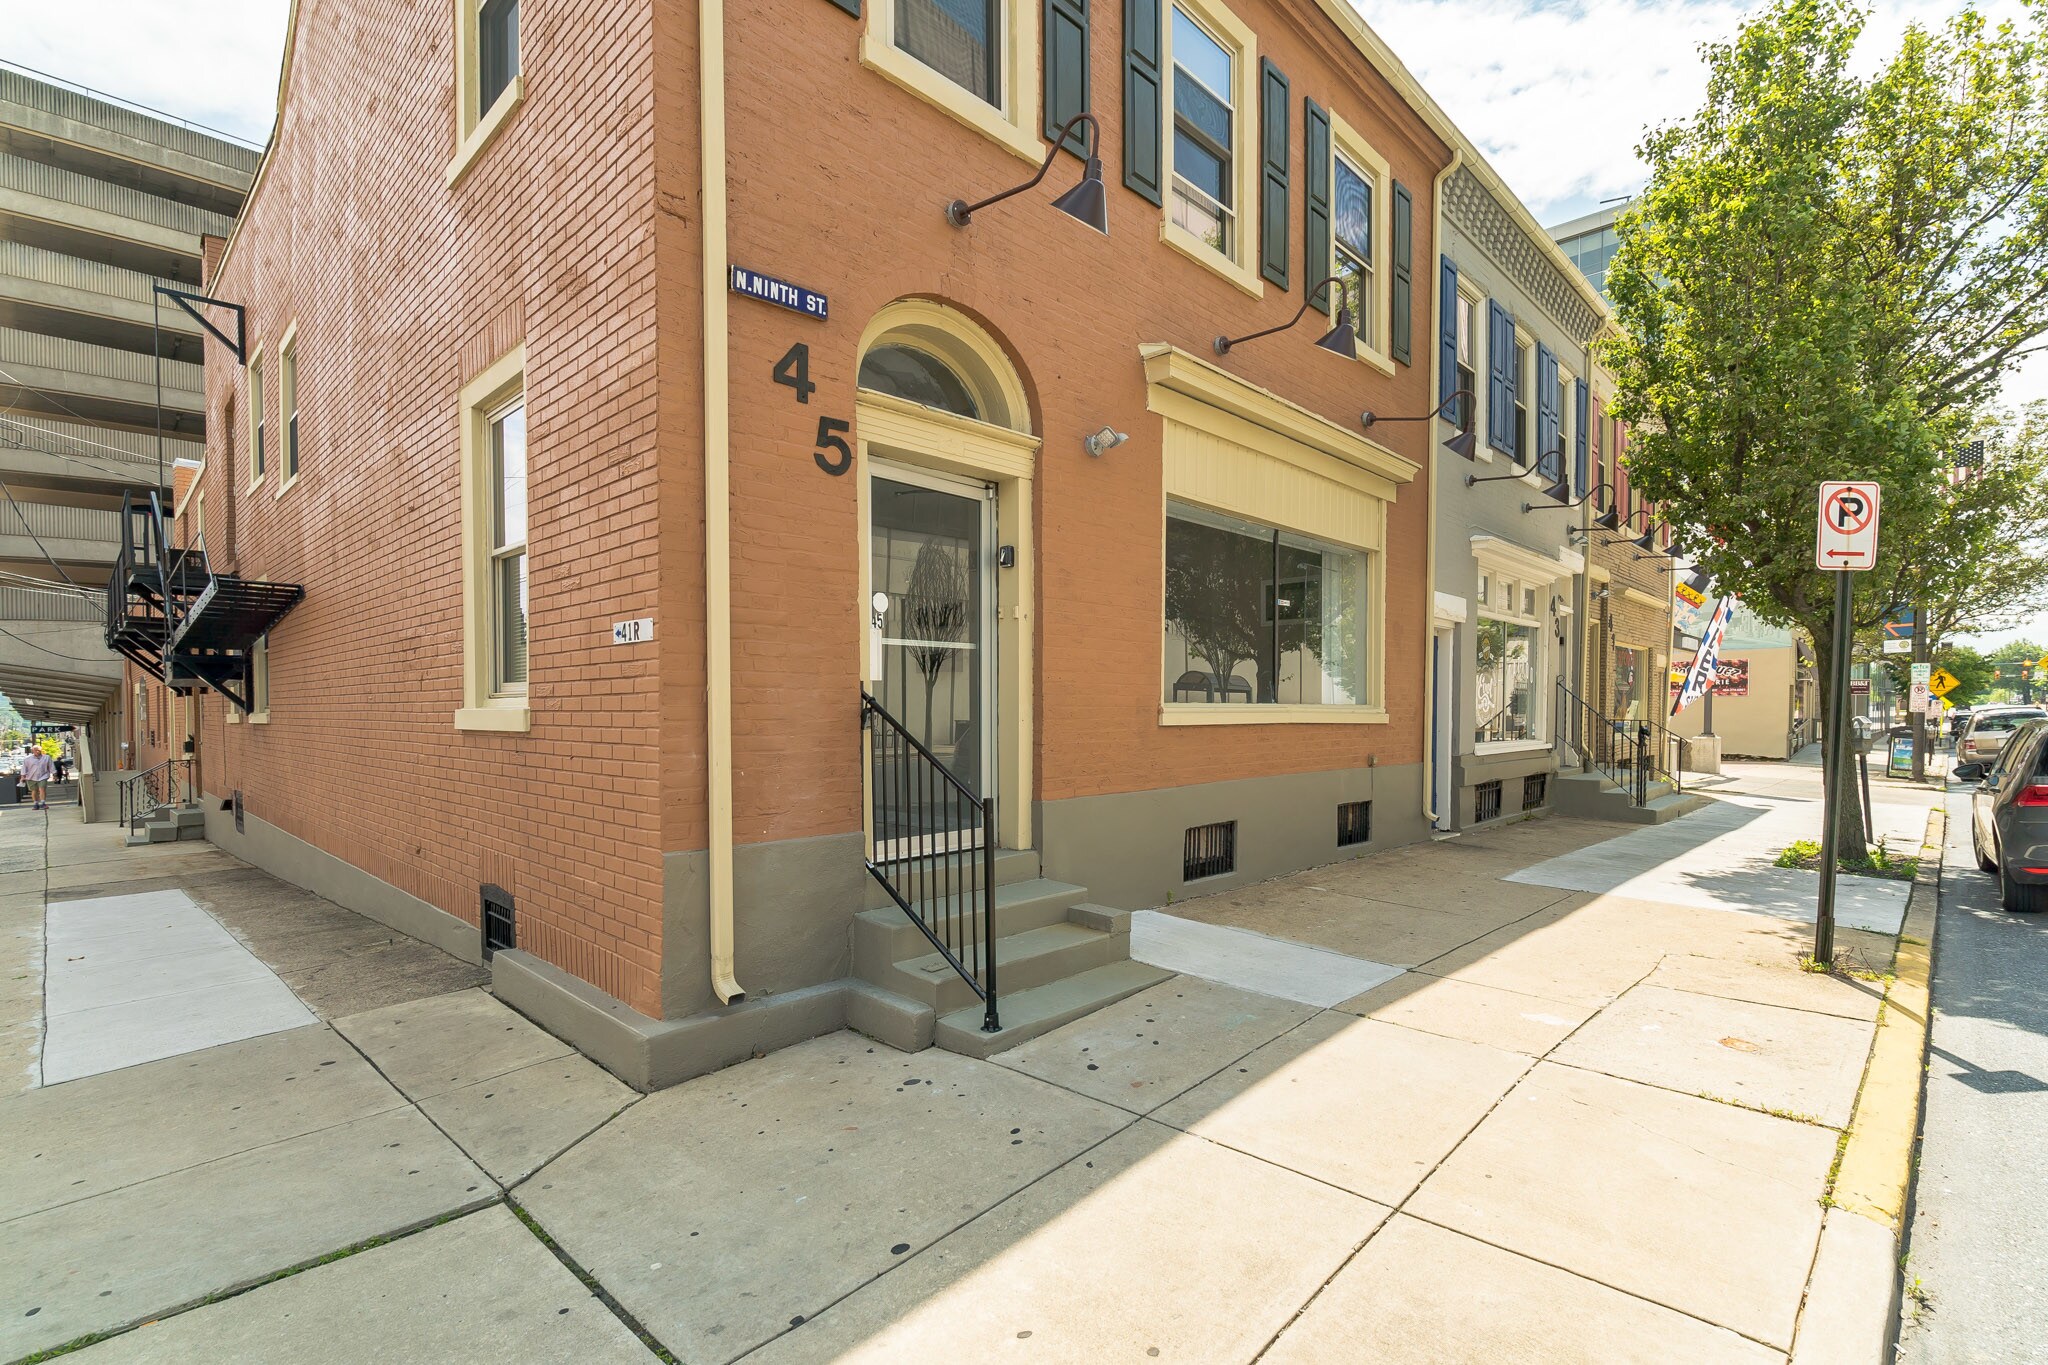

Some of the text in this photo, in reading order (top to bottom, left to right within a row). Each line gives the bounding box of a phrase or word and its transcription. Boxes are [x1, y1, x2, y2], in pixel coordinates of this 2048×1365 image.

[806, 294, 827, 316] ST.
[1838, 497, 1864, 528] P
[621, 621, 640, 642] 41R
[872, 612, 883, 630] 45
